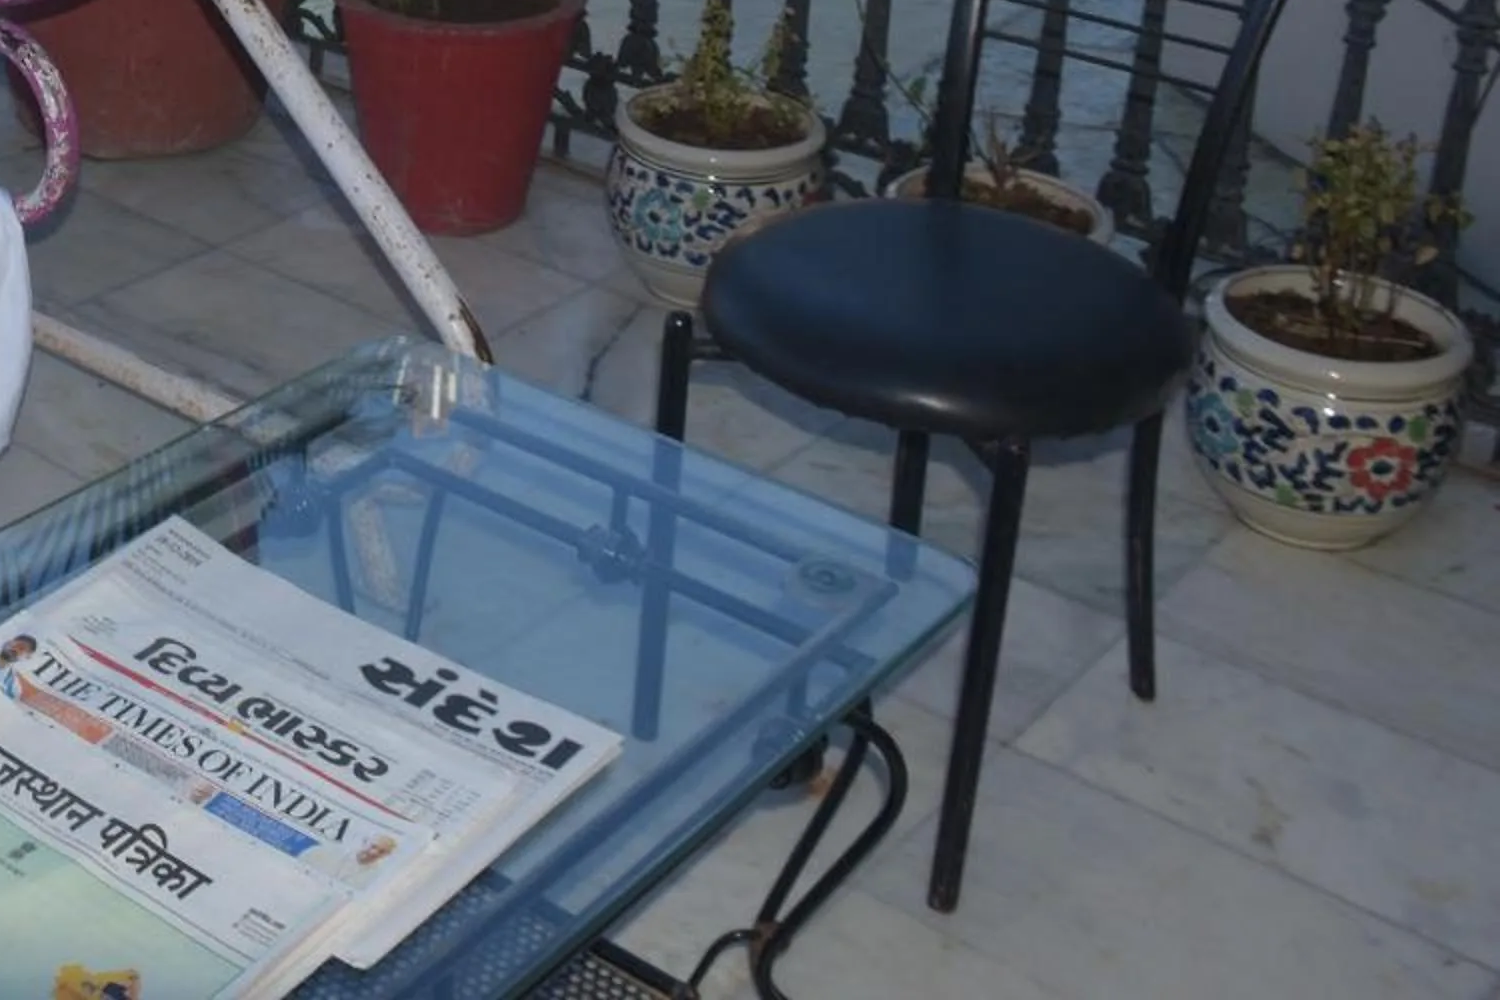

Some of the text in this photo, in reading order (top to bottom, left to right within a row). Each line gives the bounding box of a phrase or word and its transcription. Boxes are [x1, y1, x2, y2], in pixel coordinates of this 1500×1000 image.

[32, 651, 102, 701] THE
[99, 692, 204, 760] TIMES
[197, 749, 254, 784] OF
[242, 773, 351, 844] INDIA
[133, 636, 243, 704] દિવ્ય
[236, 697, 389, 783] ભાસ્કર
[359, 656, 585, 771] સંદેશ
[100, 817, 213, 900] पत्रिका
